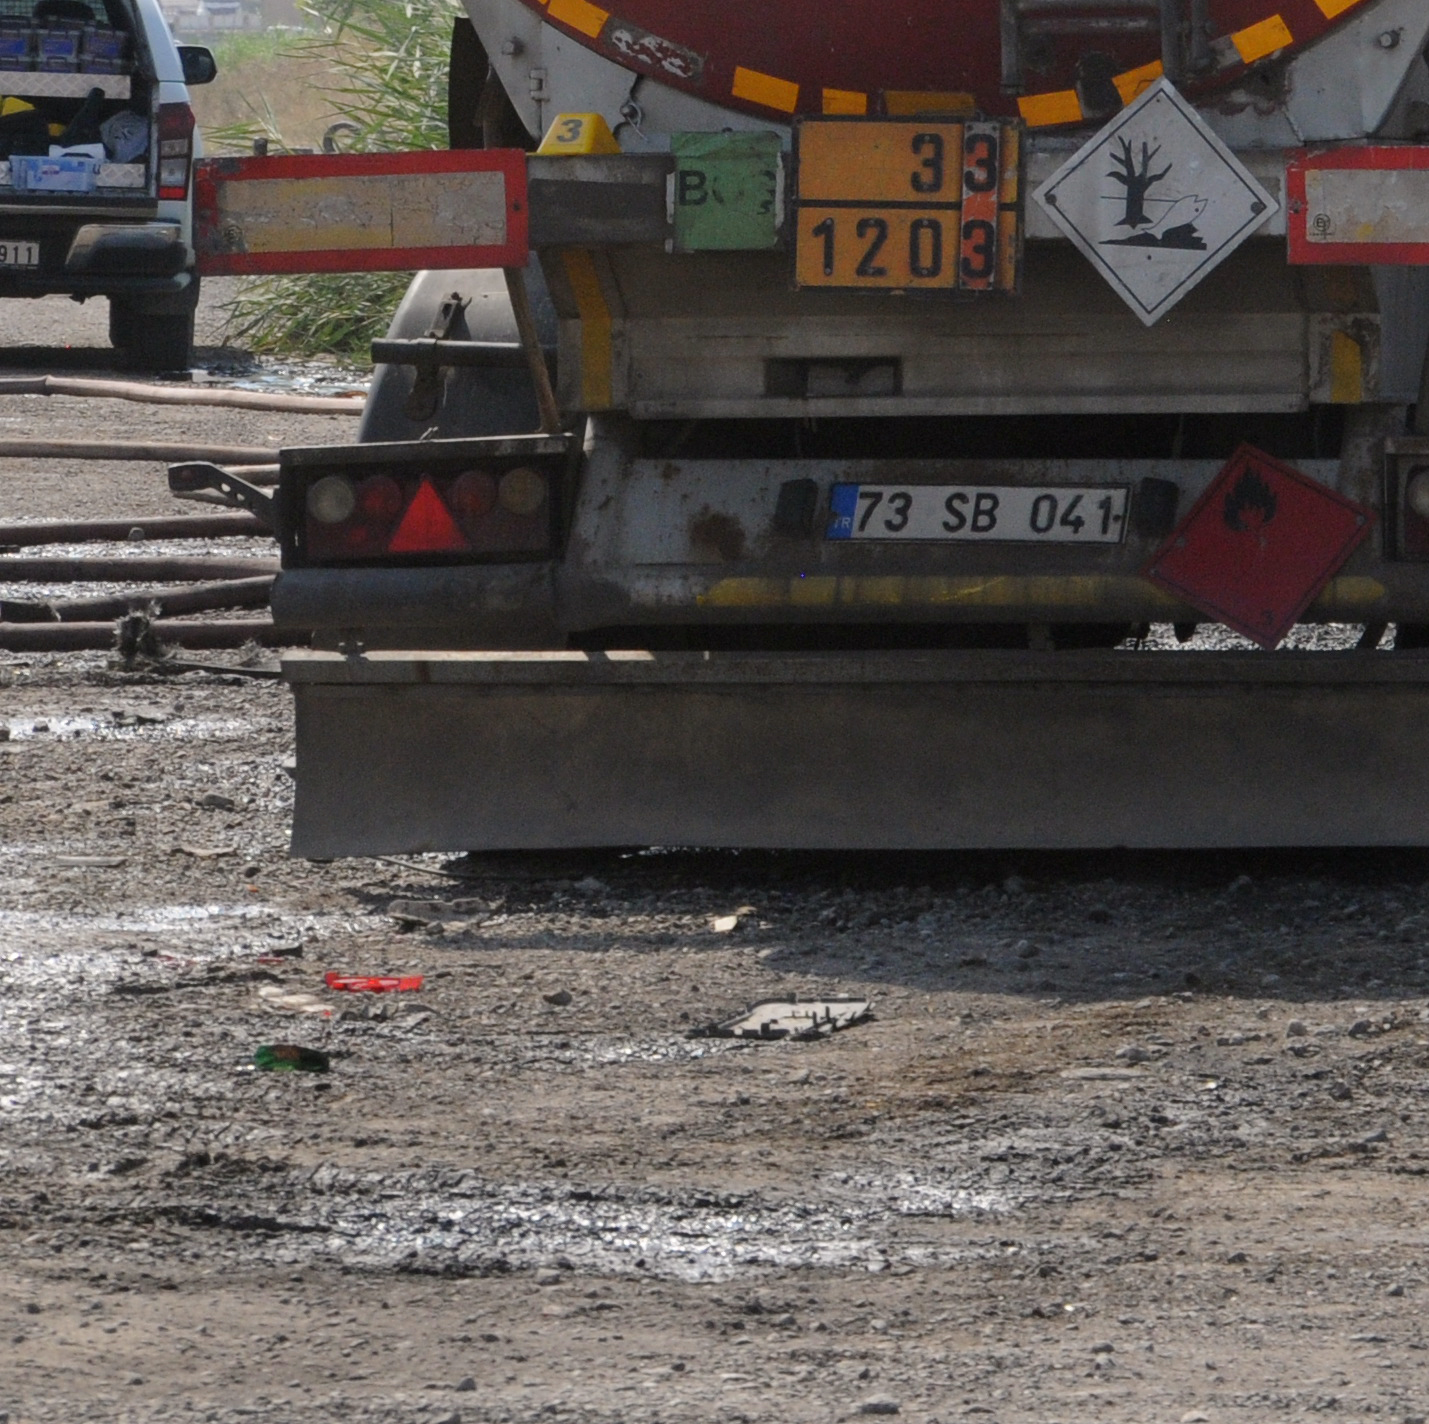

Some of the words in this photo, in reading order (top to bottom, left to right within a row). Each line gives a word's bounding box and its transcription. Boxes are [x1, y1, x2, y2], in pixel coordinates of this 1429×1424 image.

[556, 119, 583, 143] 3
[811, 217, 995, 279] 1203
[857, 491, 914, 533] 73
[941, 491, 1000, 534] SB
[1029, 492, 1113, 535] 041
